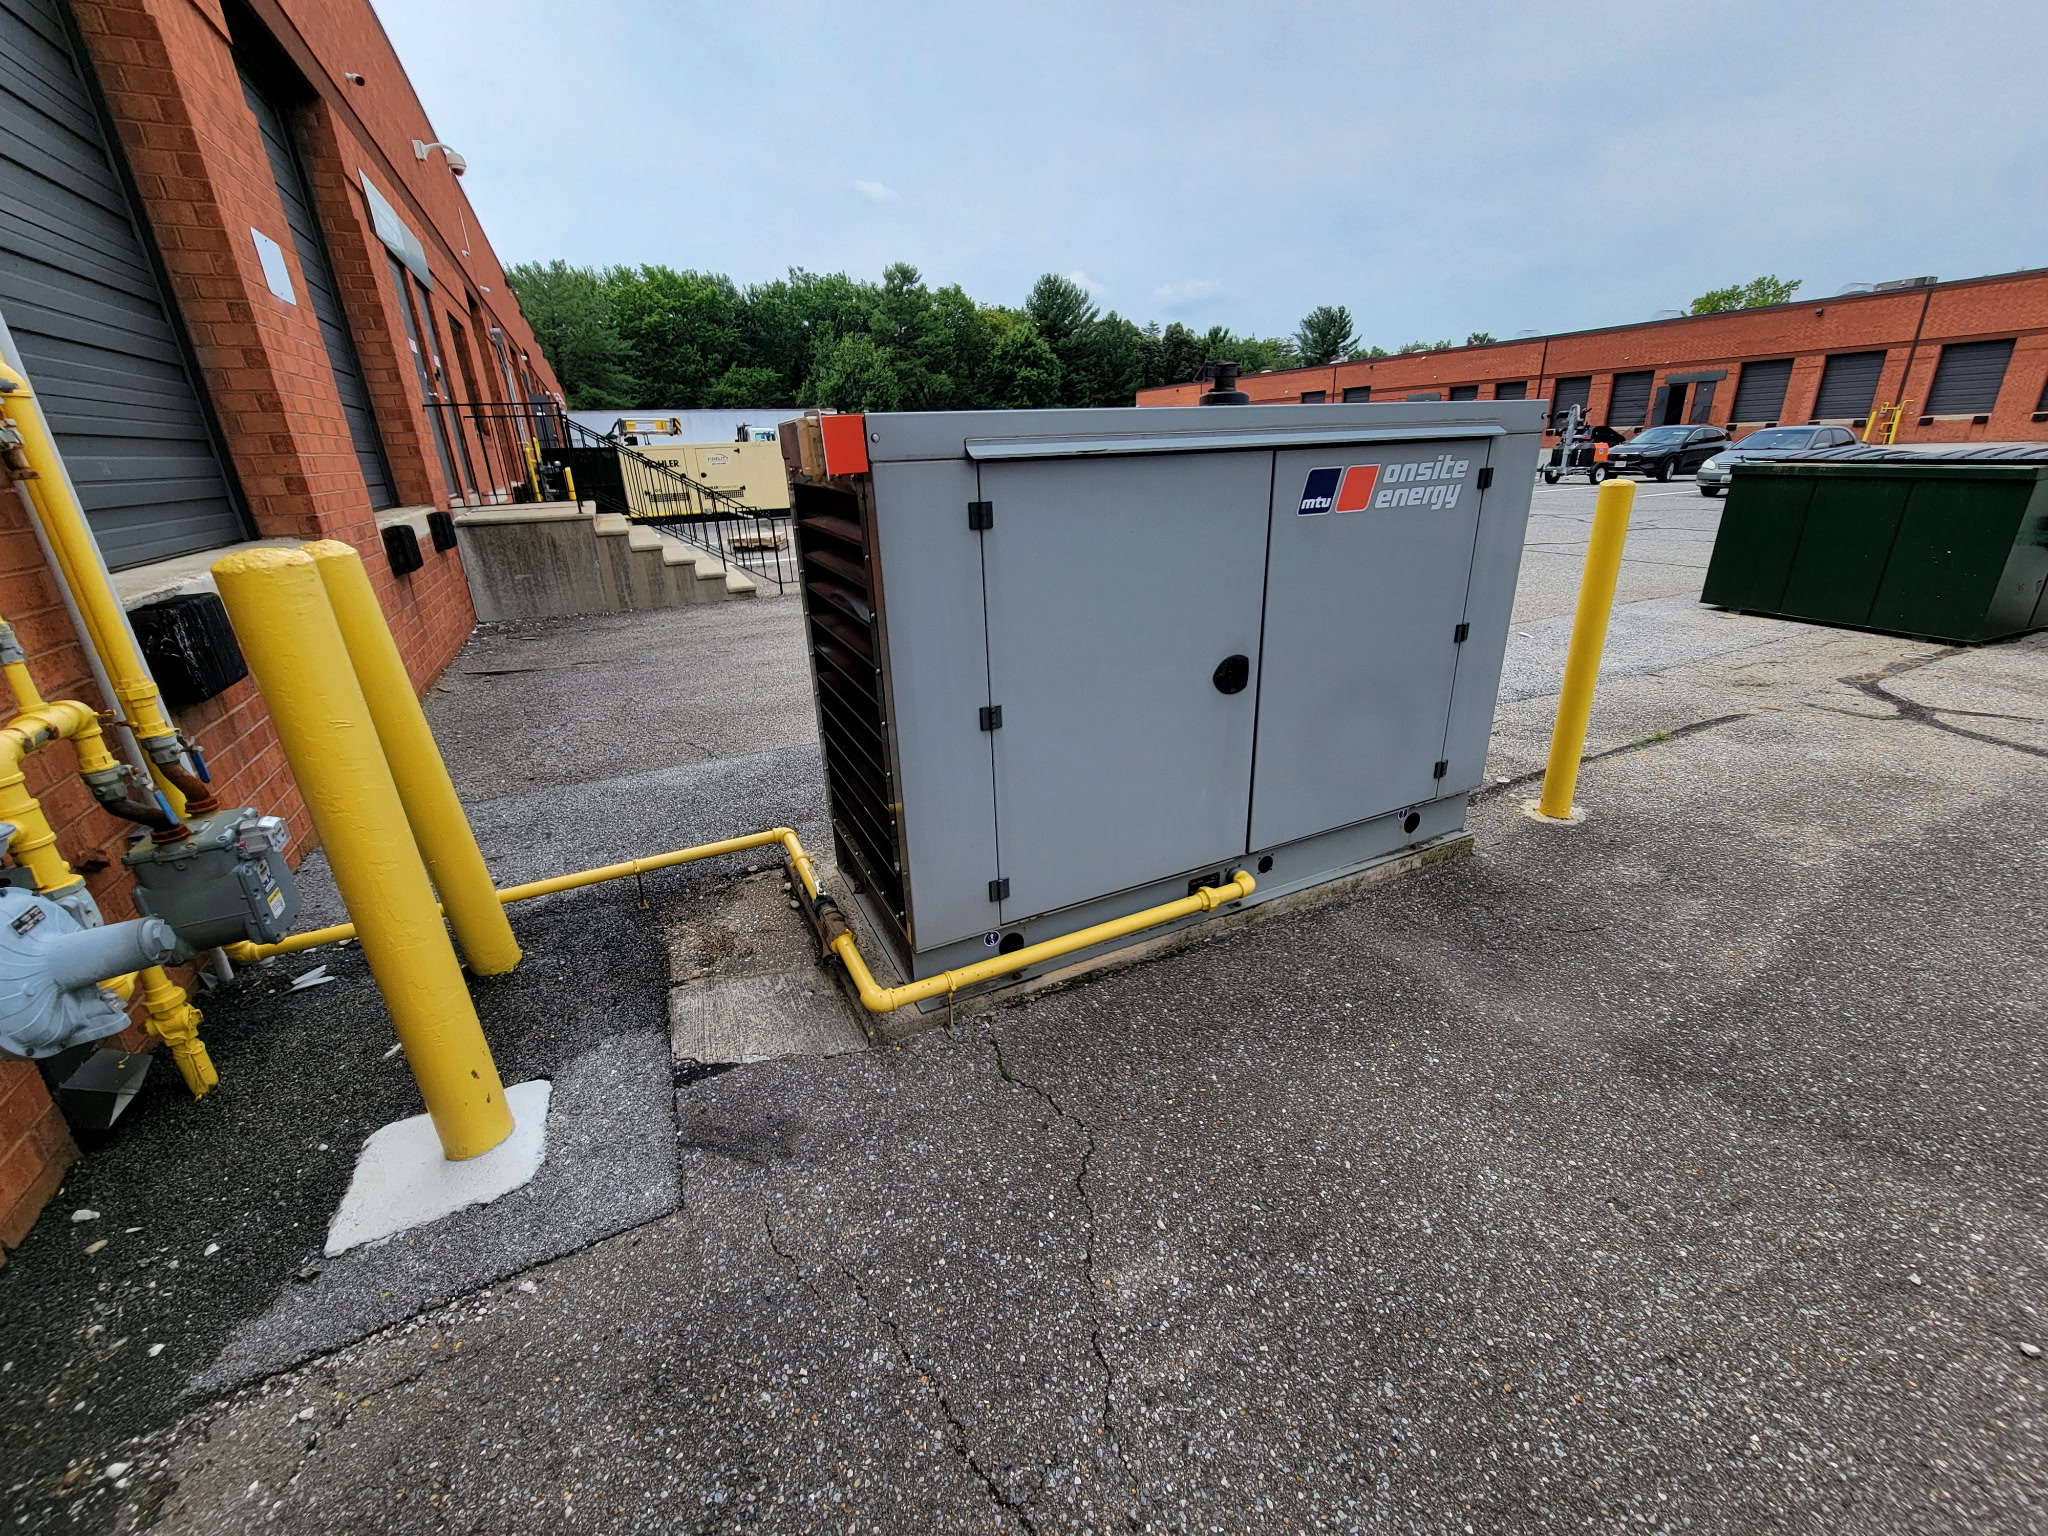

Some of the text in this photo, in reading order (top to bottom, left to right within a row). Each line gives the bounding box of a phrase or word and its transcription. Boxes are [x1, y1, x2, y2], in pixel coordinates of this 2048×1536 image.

[1382, 454, 1470, 484] onsite
[1301, 495, 1332, 510] mtu
[1374, 483, 1462, 511] energy
